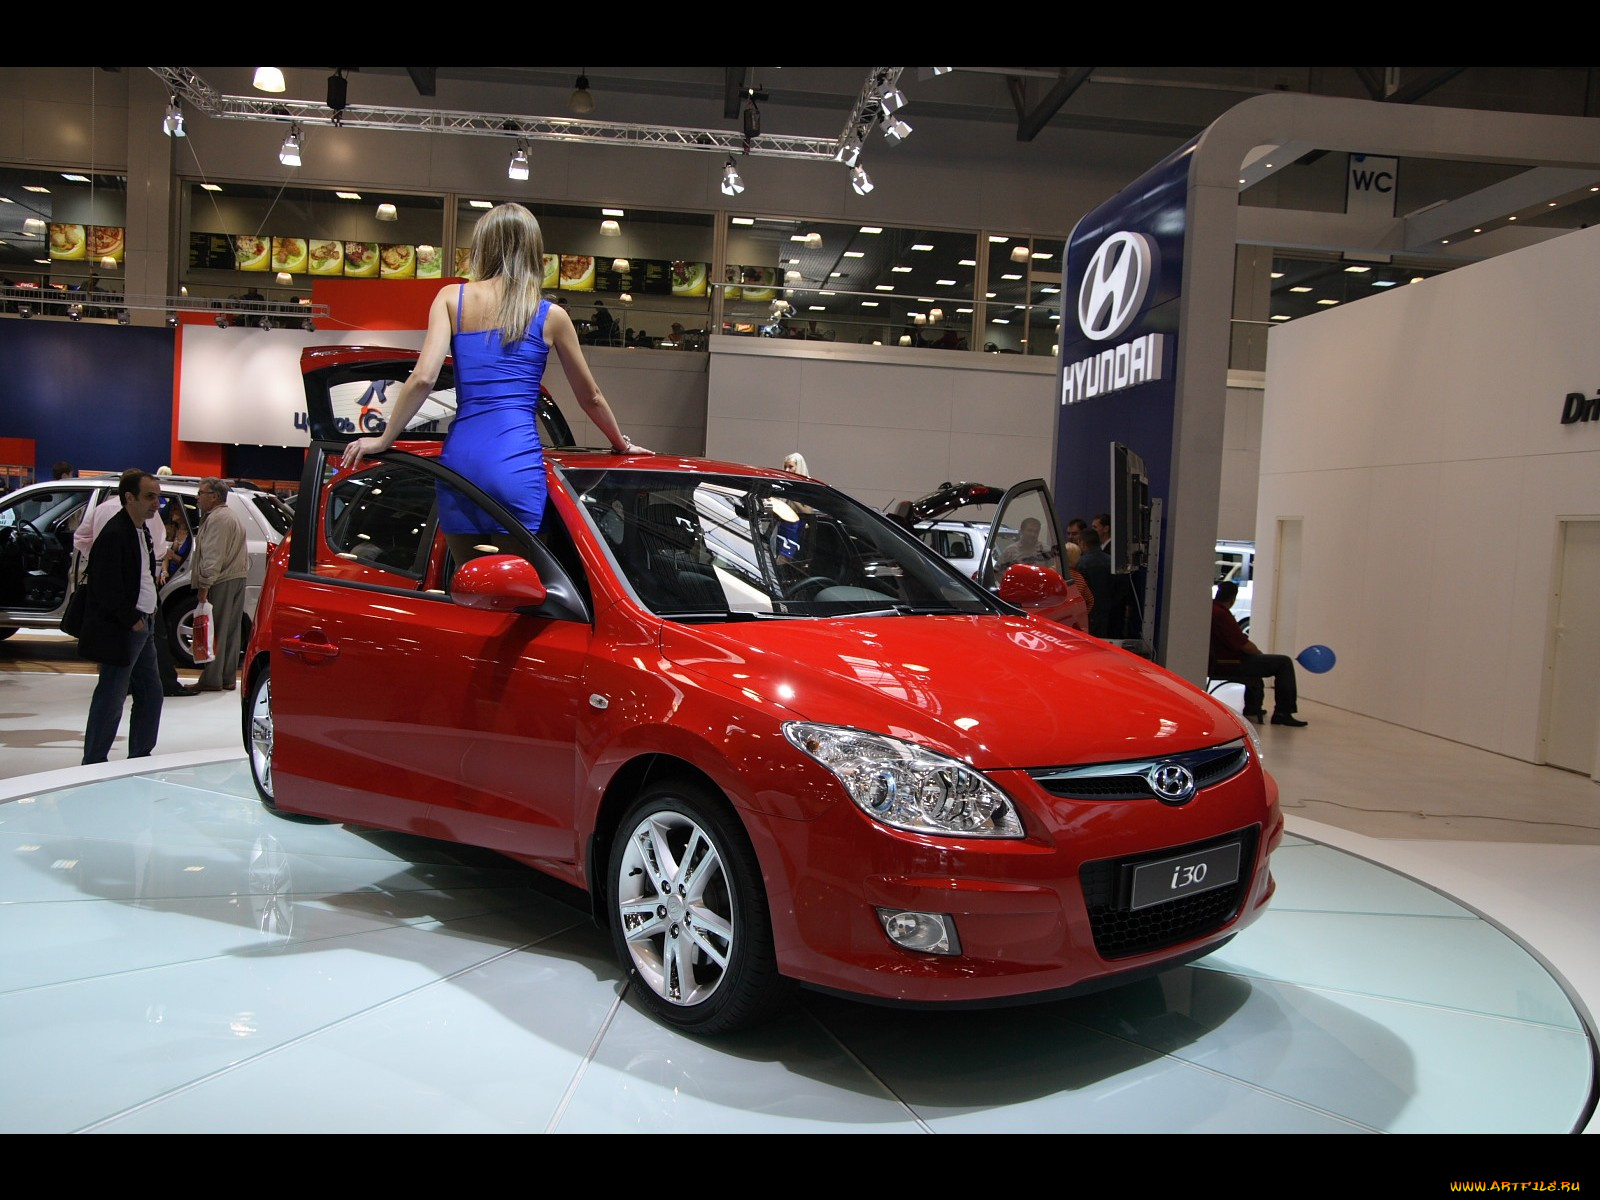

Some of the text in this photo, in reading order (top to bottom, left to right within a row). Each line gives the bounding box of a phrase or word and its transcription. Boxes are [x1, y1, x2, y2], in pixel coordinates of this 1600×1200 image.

[1352, 169, 1393, 193] WC
[1061, 333, 1162, 405] HYUNDAI
[1170, 863, 1208, 890] i30
